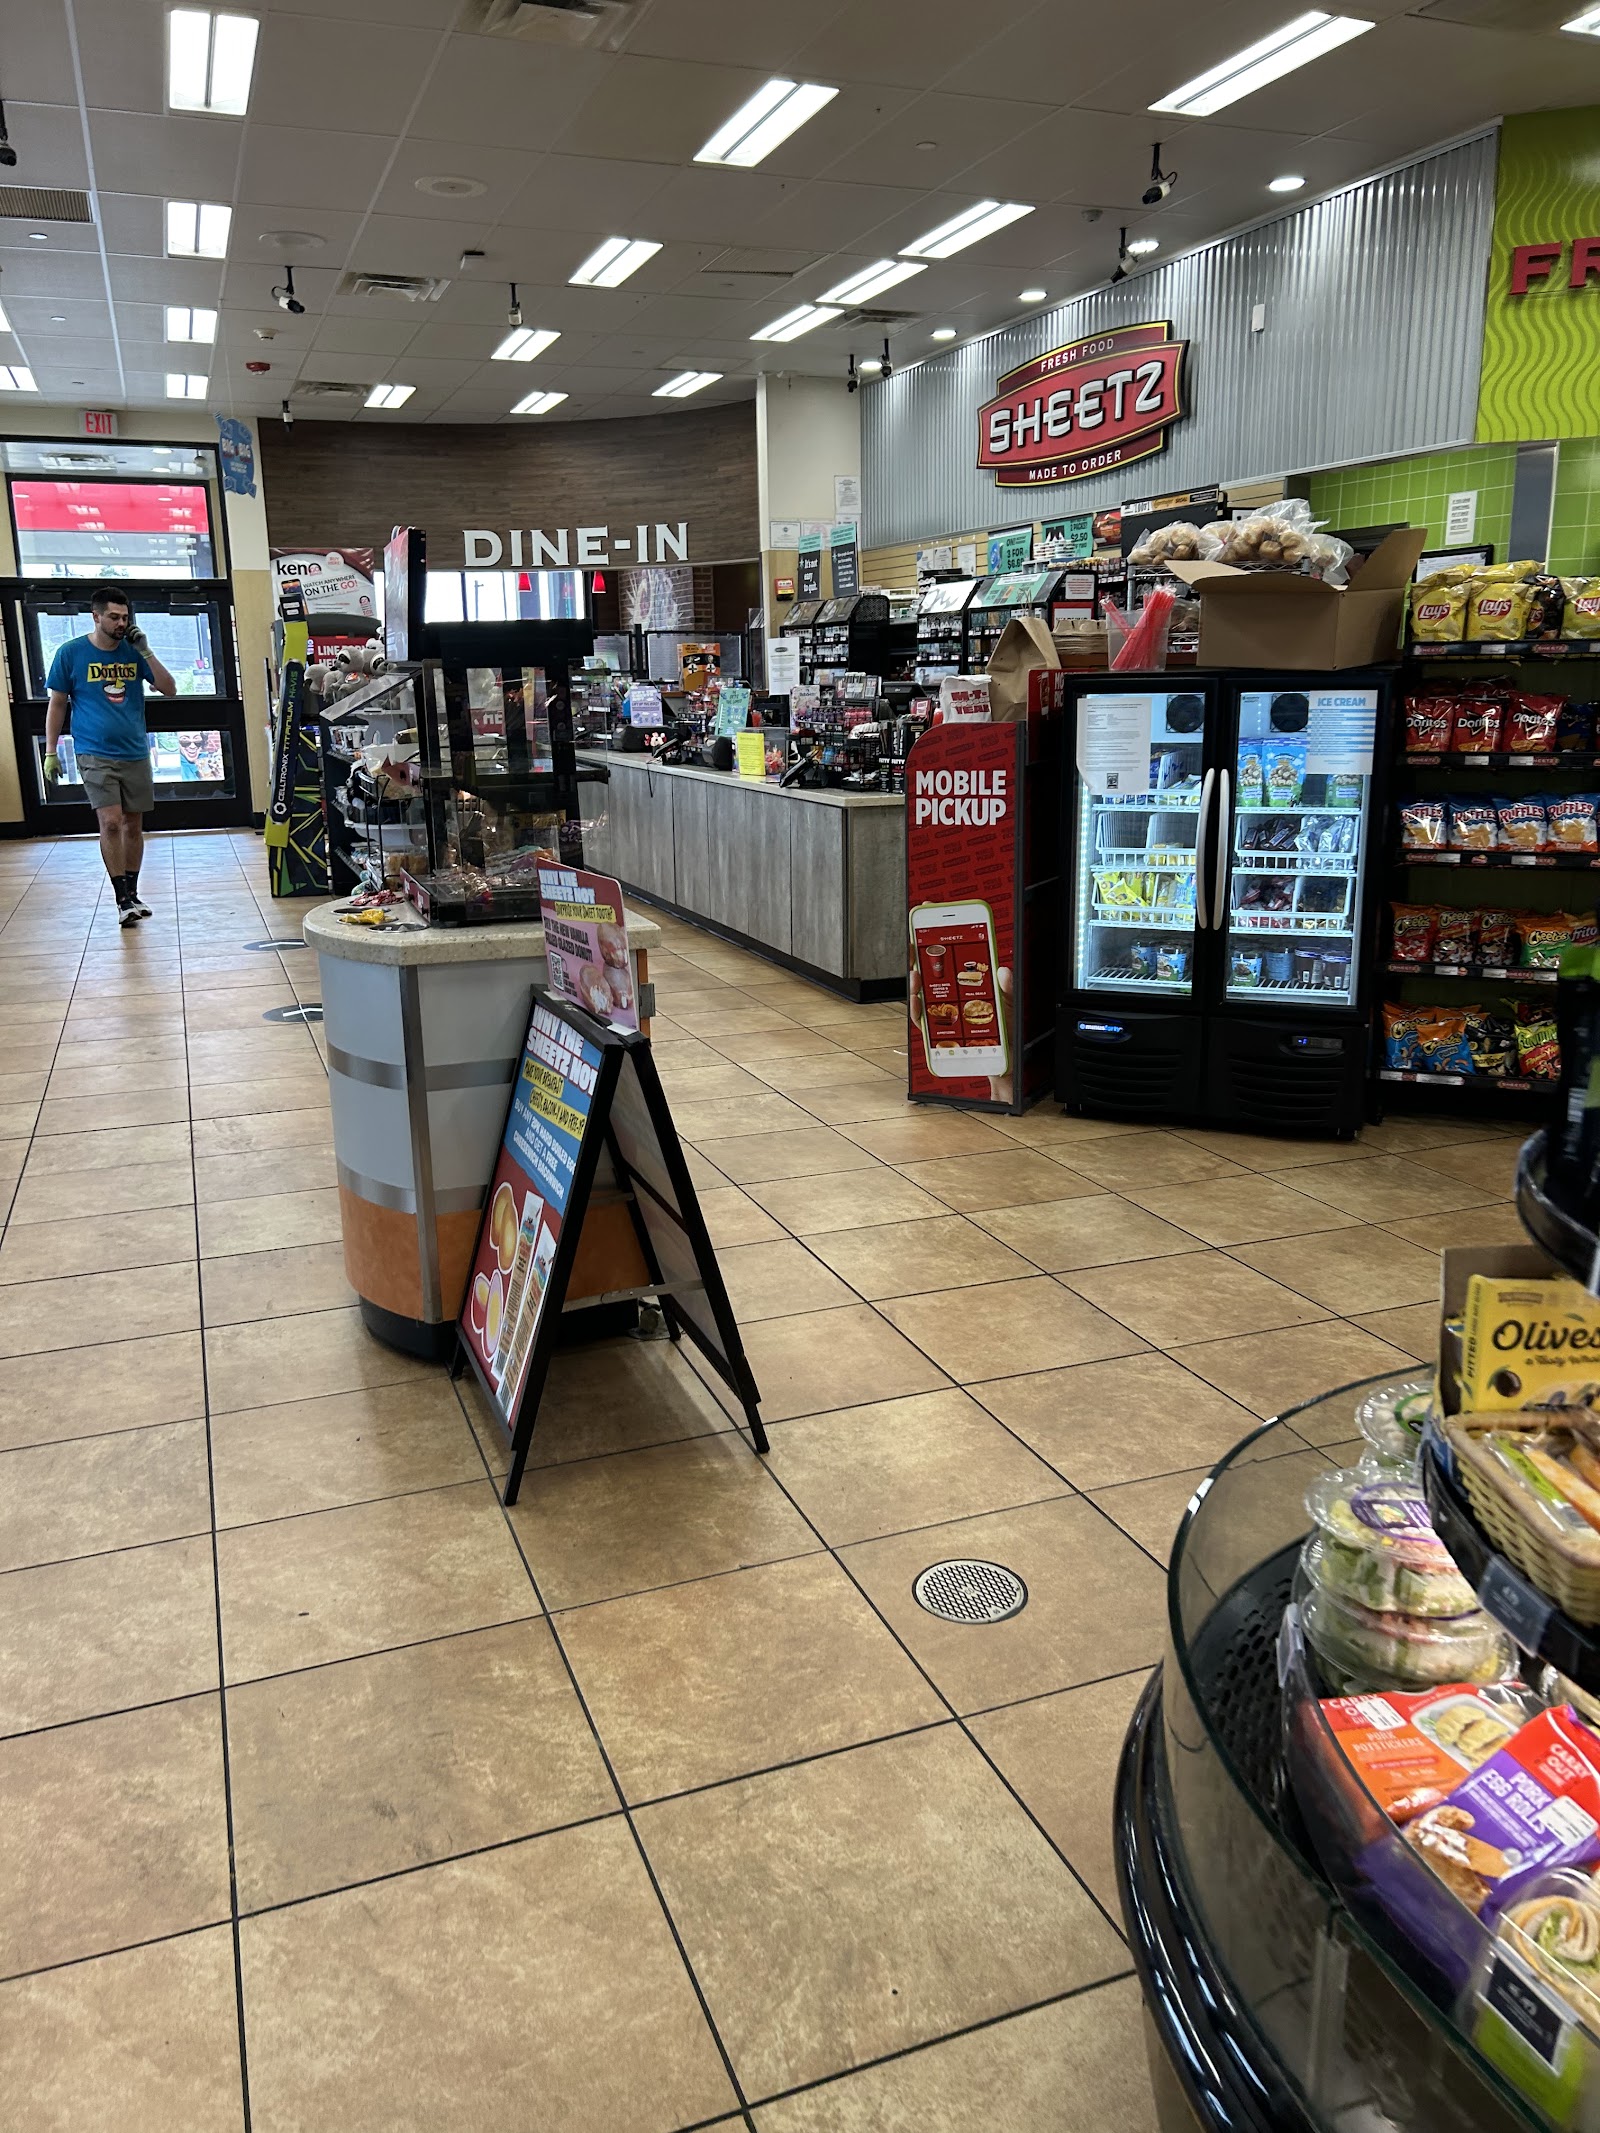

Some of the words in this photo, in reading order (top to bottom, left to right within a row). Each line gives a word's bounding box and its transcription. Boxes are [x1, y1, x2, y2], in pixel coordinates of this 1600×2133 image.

[1040, 349, 1077, 372] FRESH
[1082, 338, 1115, 357] FOOD
[989, 360, 1164, 453] SHEETZ
[85, 412, 112, 435] EXIT
[1029, 467, 1058, 480] MADE
[1062, 463, 1076, 475] TO
[1082, 450, 1122, 470] ORDER
[462, 522, 689, 567] DINE-IN
[1006, 549, 1011, 559] 3
[1012, 547, 1024, 557] FOR
[276, 559, 322, 576] keno
[302, 580, 324, 588] WATCH
[323, 574, 355, 584] ANYWHERE
[304, 587, 320, 596] ON
[321, 583, 339, 594] THE
[340, 580, 358, 590] GO!
[318, 645, 340, 656] LINE
[90, 663, 136, 679] Doritos
[1318, 698, 1332, 706] ICE
[1334, 697, 1366, 706] CREAM
[283, 701, 295, 753] TITANIUM
[1406, 717, 1448, 729] Doritos
[1457, 717, 1500, 729] Doritos
[1513, 712, 1555, 726] Doritos
[278, 753, 290, 802] CELLTRONIX
[915, 770, 1007, 795] MOBILE
[915, 798, 1007, 826] PICKUP
[1454, 807, 1496, 824] RUFFLES
[1499, 805, 1544, 823] RUFFLES
[1547, 801, 1594, 819] RUFFLES
[538, 869, 560, 886] WHY
[559, 870, 578, 887] THE
[540, 884, 574, 901] SHEETZ
[574, 887, 595, 904] NOT
[551, 919, 559, 935] THE
[559, 922, 570, 938] NEW
[569, 926, 589, 946] VANILLA
[1527, 929, 1570, 946] Cheetos
[533, 1004, 562, 1037] WHY
[559, 1020, 585, 1055] THE
[1422, 1034, 1463, 1056] Cheetos
[526, 1027, 573, 1078] SHEETZ
[569, 1056, 598, 1096] NOT
[514, 1098, 525, 1115] BUY
[522, 1107, 533, 1124] ANY
[539, 1125, 553, 1147] HARD
[551, 1138, 569, 1165] BOILED
[524, 1127, 536, 1145] AND
[533, 1136, 544, 1153] GET
[541, 1146, 547, 1160] A
[545, 1150, 559, 1173] FREE
[1491, 1319, 1600, 1351] Olives
[1467, 1337, 1477, 1379] PITTED
[1352, 1737, 1425, 1752] POTSTICKERS
[1367, 1731, 1397, 1741] PORK
[1546, 1754, 1577, 1782] OUT
[1480, 1767, 1514, 1797] EGG
[1509, 1771, 1554, 1810] PORK
